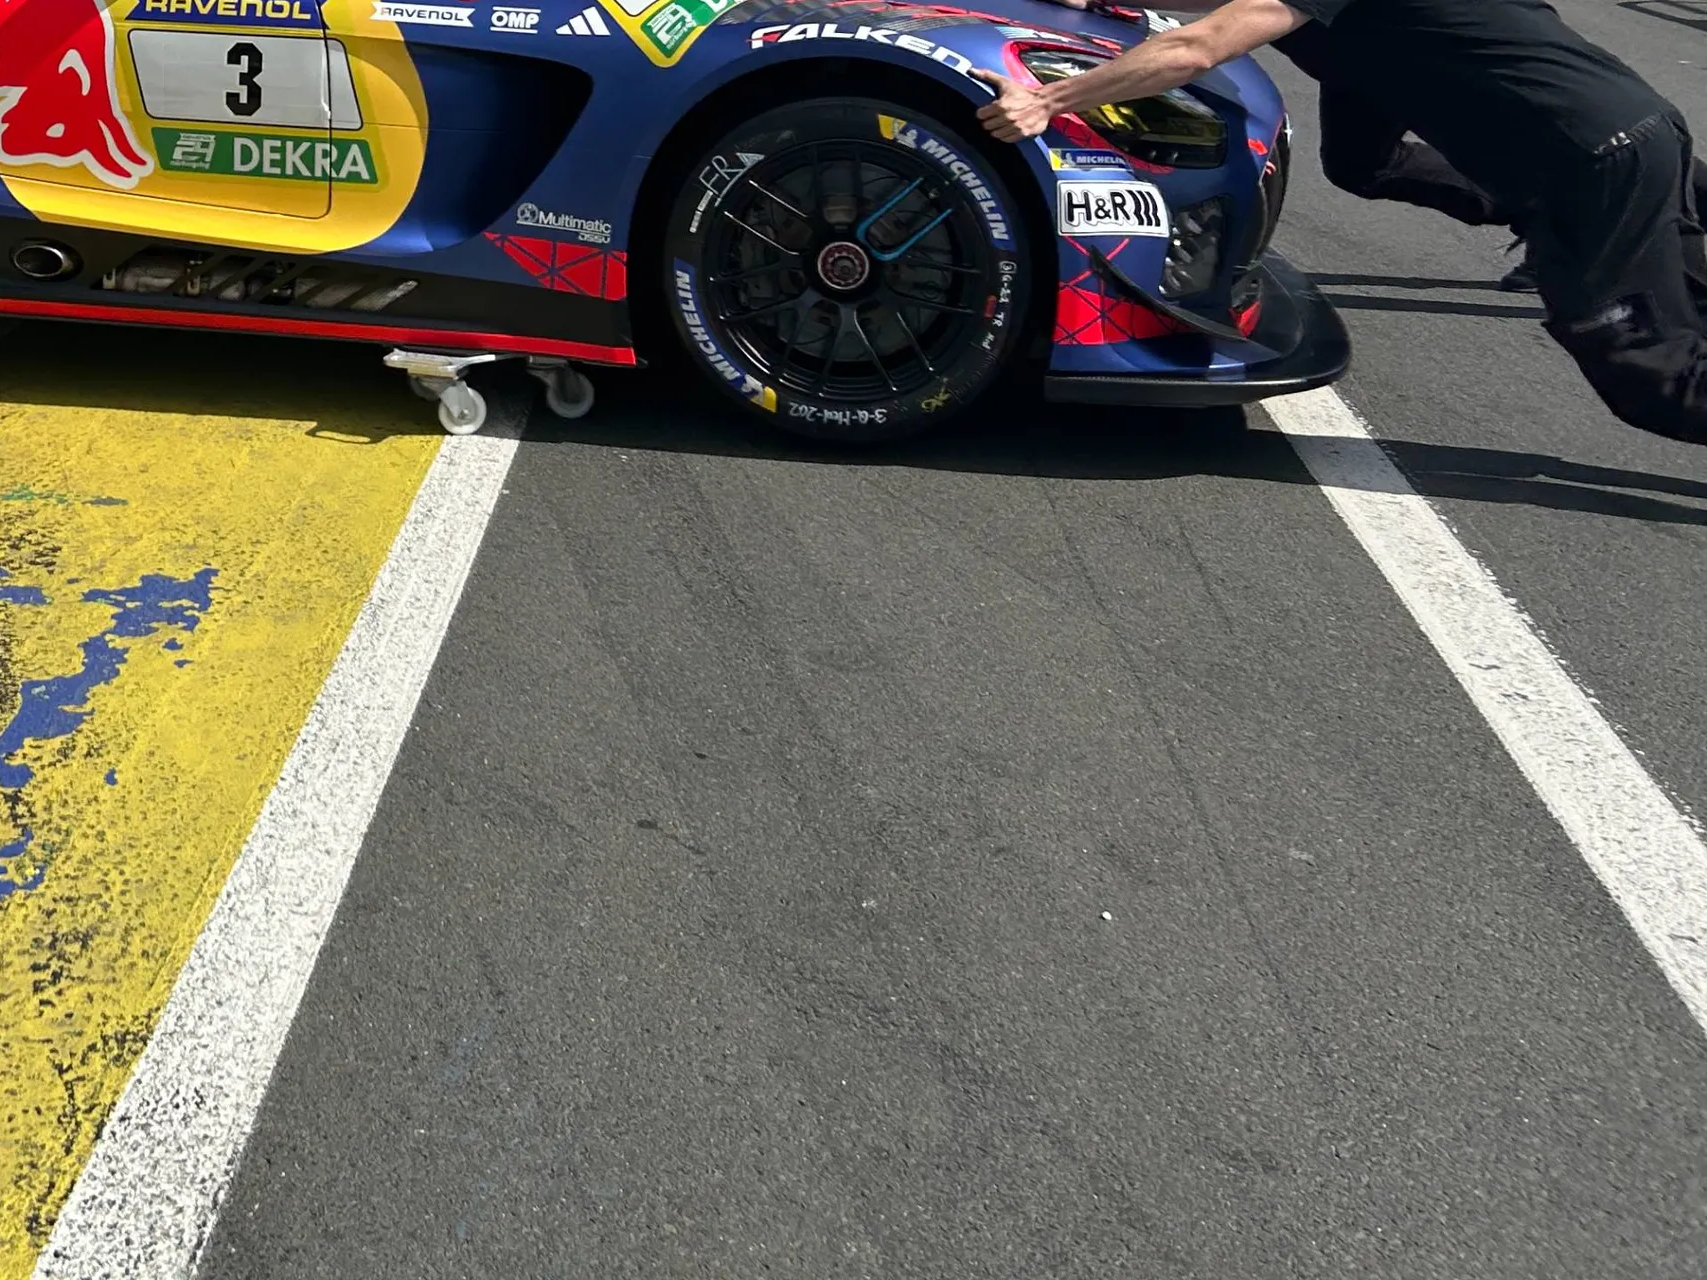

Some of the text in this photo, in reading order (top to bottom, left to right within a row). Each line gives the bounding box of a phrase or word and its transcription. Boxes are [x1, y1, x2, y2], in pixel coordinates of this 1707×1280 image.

[381, 6, 464, 22] RAVENOL
[491, 10, 540, 31] OMP
[225, 42, 263, 117] 3
[233, 136, 371, 180] DEKRA
[920, 139, 1011, 241] MICHELIN
[1066, 190, 1131, 223] H&R
[539, 210, 612, 234] Multimatic
[675, 270, 740, 382] MICHELIN
